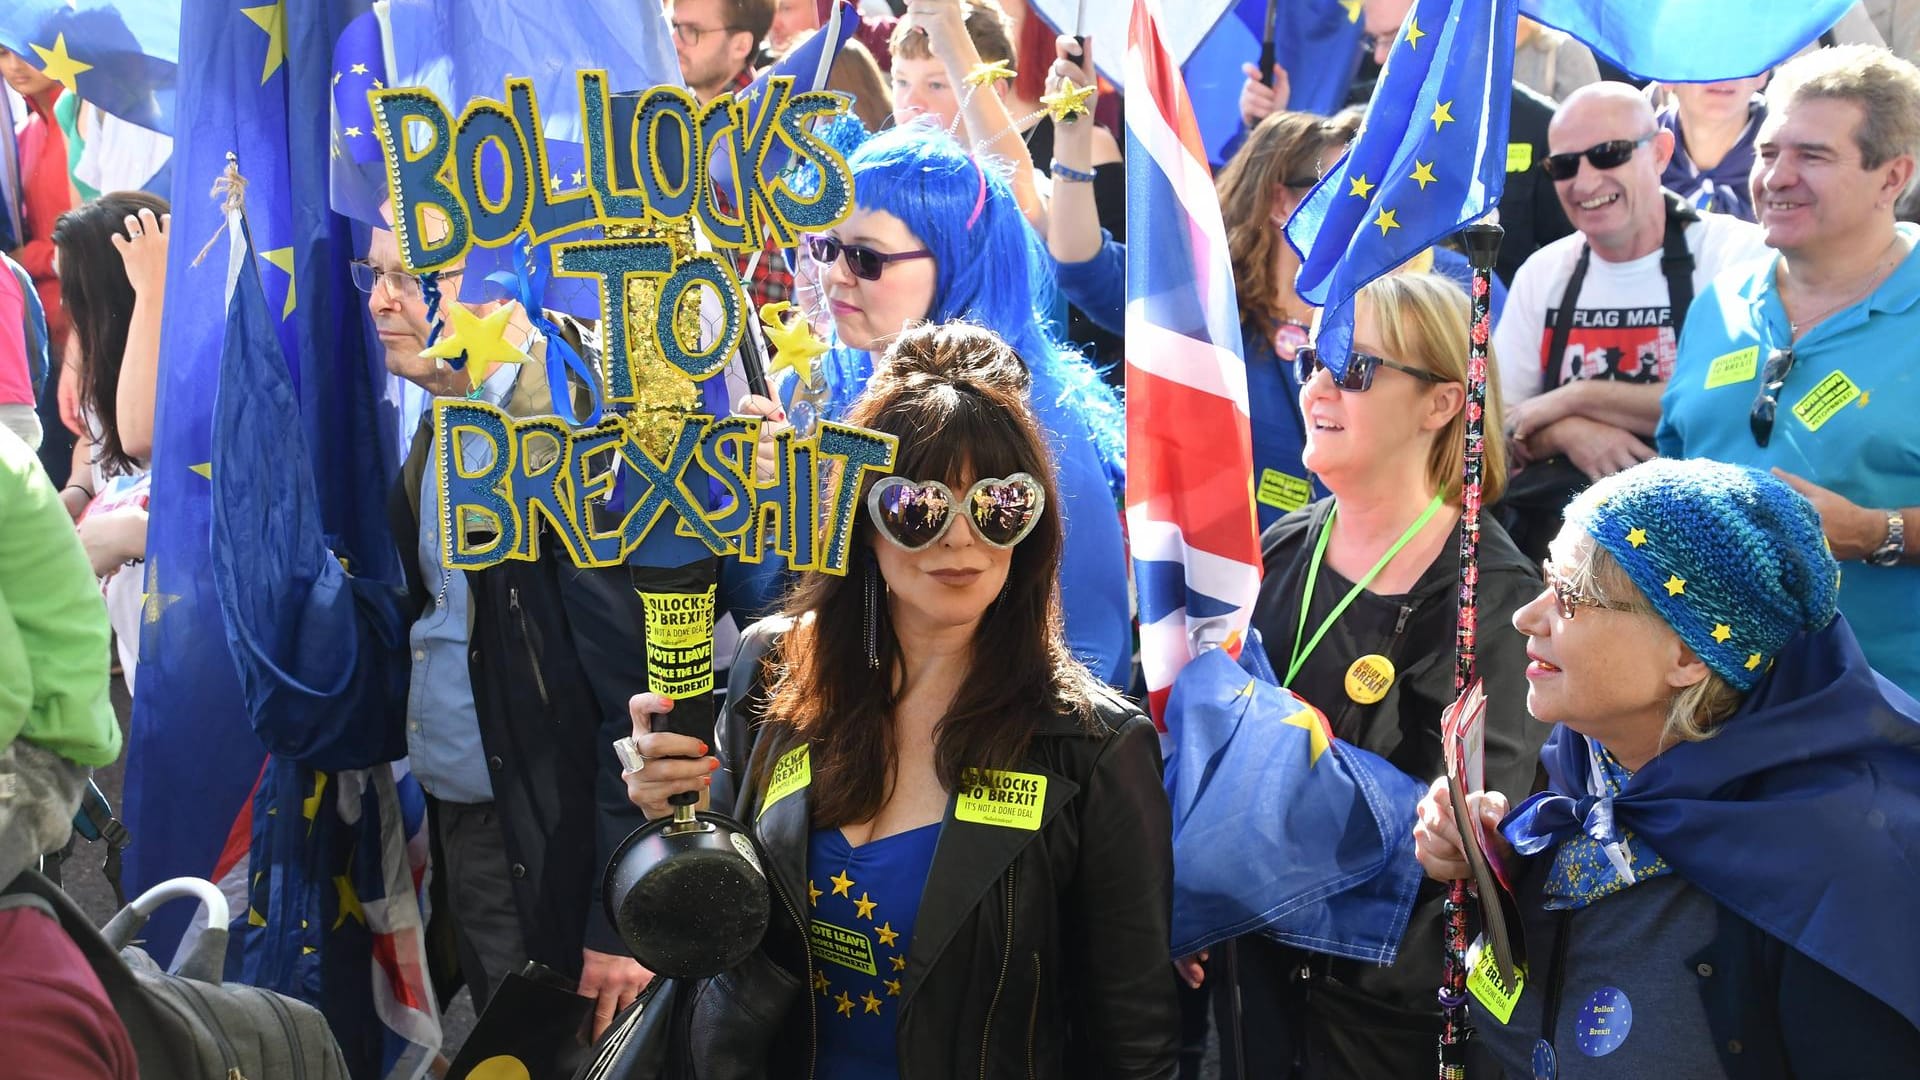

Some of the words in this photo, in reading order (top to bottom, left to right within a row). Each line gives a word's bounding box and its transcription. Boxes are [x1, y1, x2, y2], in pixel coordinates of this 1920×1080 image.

[367, 69, 855, 274] BOLLOCKS
[552, 238, 746, 404] TO
[1573, 310, 1620, 327] FLAG
[1627, 309, 1673, 326] MAF
[433, 397, 899, 575] BREXSHIT
[649, 598, 706, 611] OLLOCKS
[660, 611, 705, 625] BREXIT
[648, 643, 677, 664] VOTE
[678, 644, 711, 663] LEAVE
[675, 665, 692, 678] THE
[693, 661, 711, 674] LAW
[1352, 666, 1384, 694] BREXIT
[777, 750, 805, 772] OCKS
[775, 760, 805, 784] REXIT
[988, 789, 1038, 806] BREXIT
[964, 801, 976, 810] IT'S
[977, 803, 991, 813] NOT
[998, 806, 1016, 816] DONE
[1017, 808, 1033, 818] DEAL
[811, 924, 833, 939] OTE
[833, 930, 867, 949] LEAVE
[1496, 996, 1507, 1011] DEAL
[1593, 1005, 1615, 1013] Bollox
[1589, 1028, 1611, 1036] Brexit
